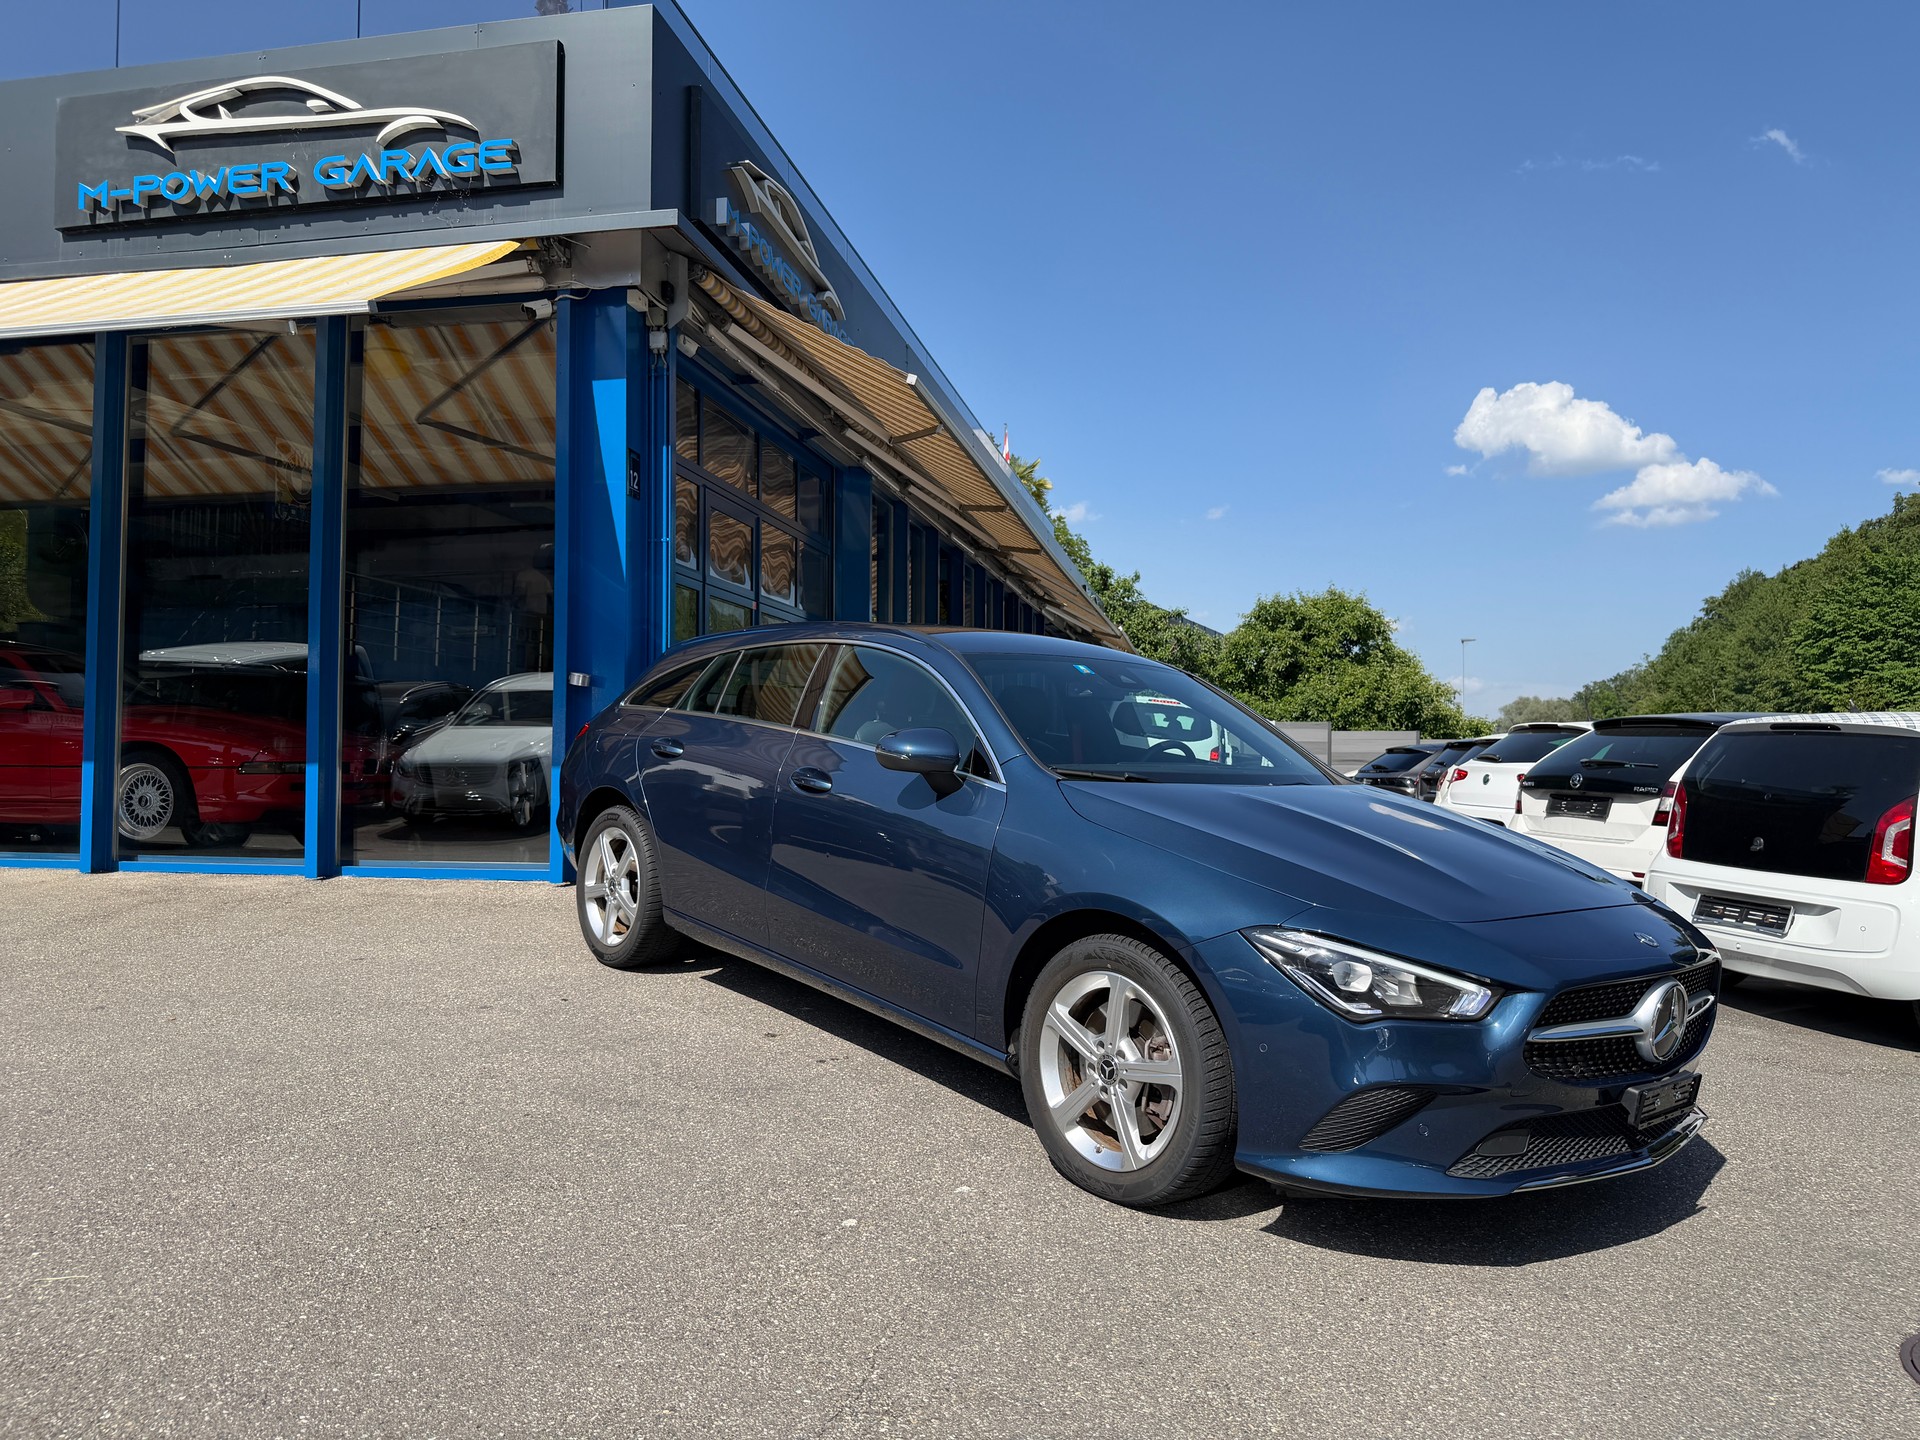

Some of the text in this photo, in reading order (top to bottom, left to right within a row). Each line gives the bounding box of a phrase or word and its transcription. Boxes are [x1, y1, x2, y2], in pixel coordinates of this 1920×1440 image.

[78, 139, 513, 211] M-POWER GARAGE
[718, 198, 801, 301] M-POWER
[630, 469, 639, 490] 12
